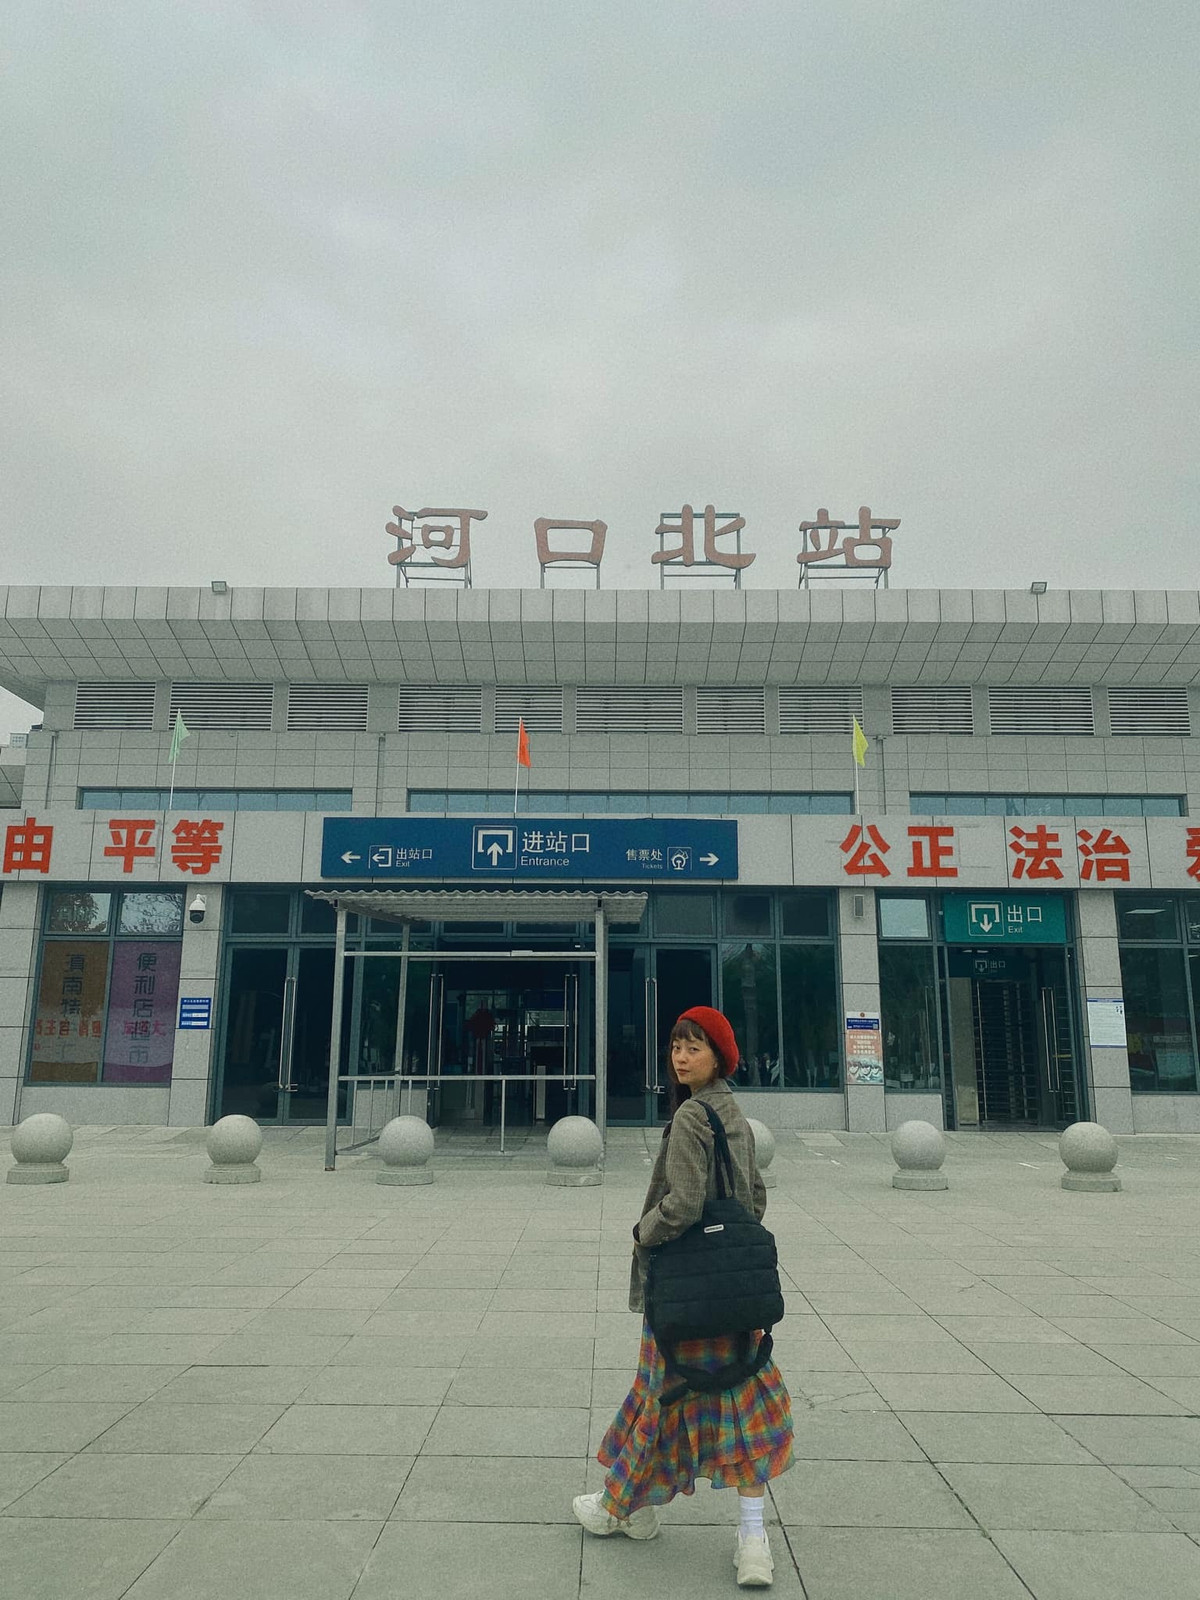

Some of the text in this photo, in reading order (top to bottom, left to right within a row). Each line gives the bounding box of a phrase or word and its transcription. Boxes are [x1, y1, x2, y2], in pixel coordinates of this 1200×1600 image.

[385, 504, 901, 569] 河口北站
[2, 817, 224, 875] 由 平等
[521, 830, 591, 854] 进站口
[395, 847, 434, 860] 出站口
[625, 847, 664, 862] 售票处
[839, 825, 959, 878] 公正
[1009, 825, 1132, 881] 法治
[395, 860, 411, 868] Exit
[520, 855, 570, 867] Entrance
[641, 862, 664, 870] Tickets
[1007, 903, 1043, 924] 出口
[1007, 925, 1024, 934] Exit
